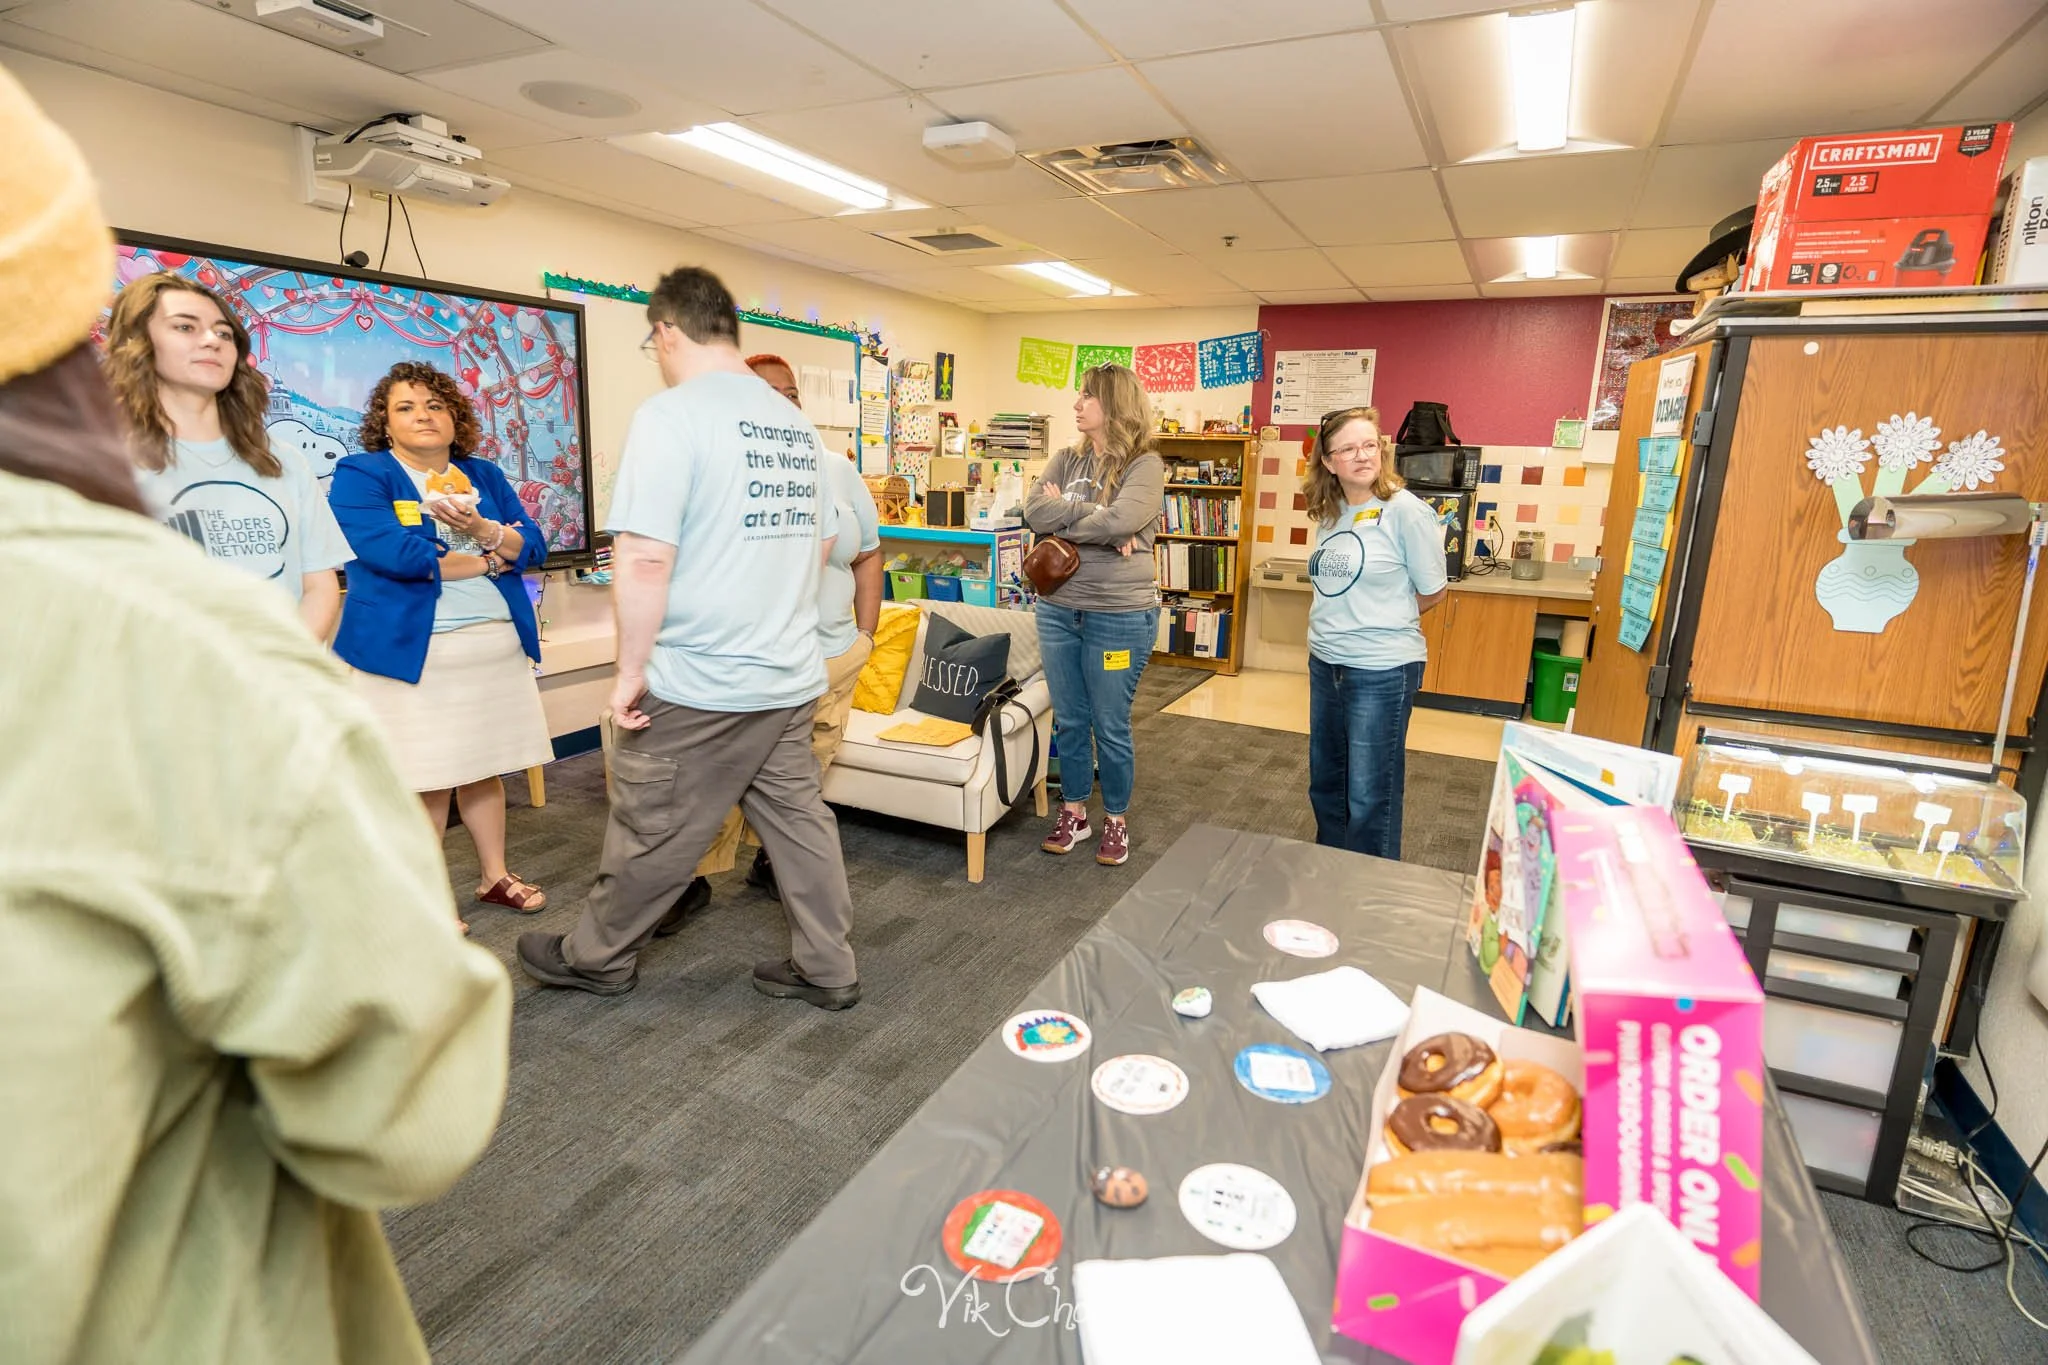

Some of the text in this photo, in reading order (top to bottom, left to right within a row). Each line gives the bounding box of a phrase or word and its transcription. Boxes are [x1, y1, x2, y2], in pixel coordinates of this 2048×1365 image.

[1819, 142, 1931, 162] CRAFTSMAN
[1816, 178, 1830, 189] 2.5
[1850, 175, 1867, 187] 2.5
[739, 420, 814, 450] Changing
[746, 450, 817, 472] the World
[748, 480, 785, 499] One
[199, 510, 225, 520] THE
[744, 507, 817, 528] at a Time
[206, 518, 272, 532] LEADERS
[208, 530, 276, 545] READERS
[1320, 561, 1349, 570] READERS
[1320, 569, 1353, 579] NETWORK
[1679, 1023, 1722, 1268] ORDER ONL
